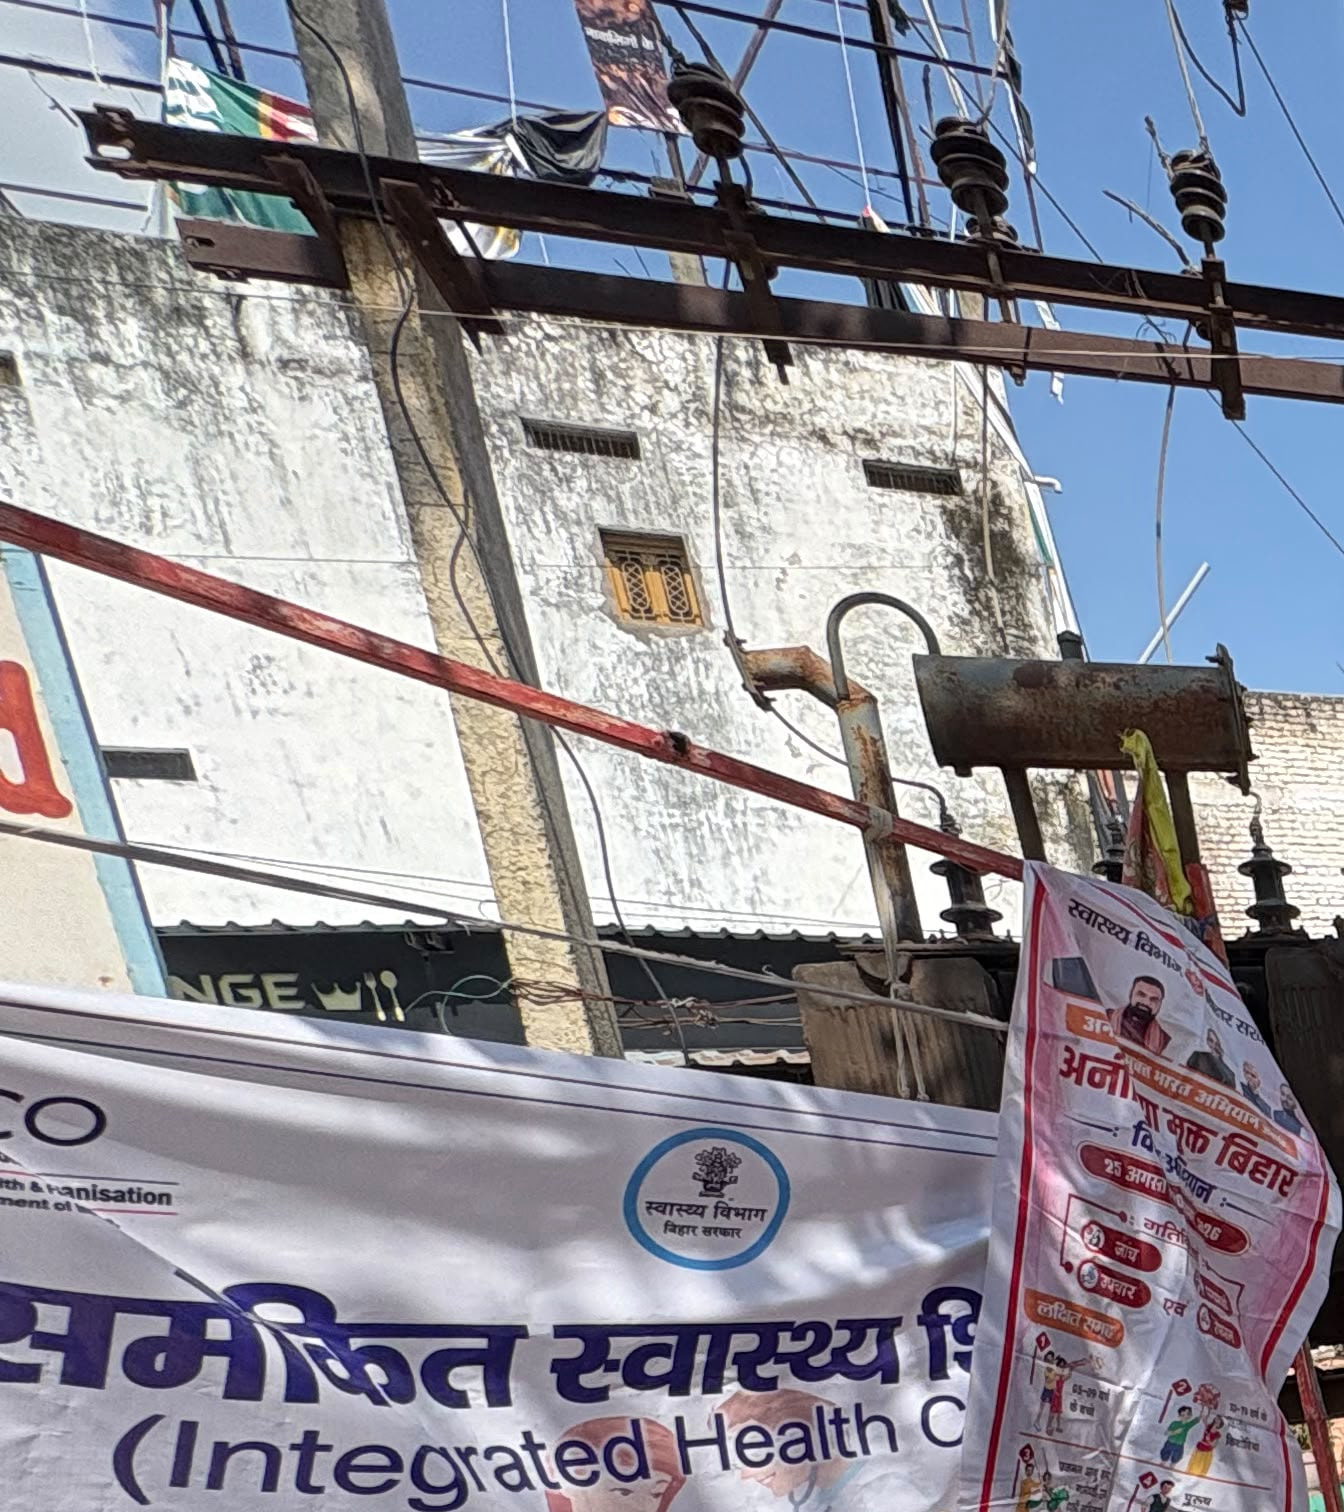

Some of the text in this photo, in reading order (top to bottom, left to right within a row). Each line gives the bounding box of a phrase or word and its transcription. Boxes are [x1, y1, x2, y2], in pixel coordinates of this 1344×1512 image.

[169, 972, 305, 1010] NGE
[1214, 1131, 1299, 1199] बिहार
[645, 1199, 768, 1223] स्वास्थ्य विभाग
[549, 1315, 903, 1404] स्वास्थ्य
[112, 1412, 654, 1512] (Integrated
[675, 1402, 899, 1475] Health
